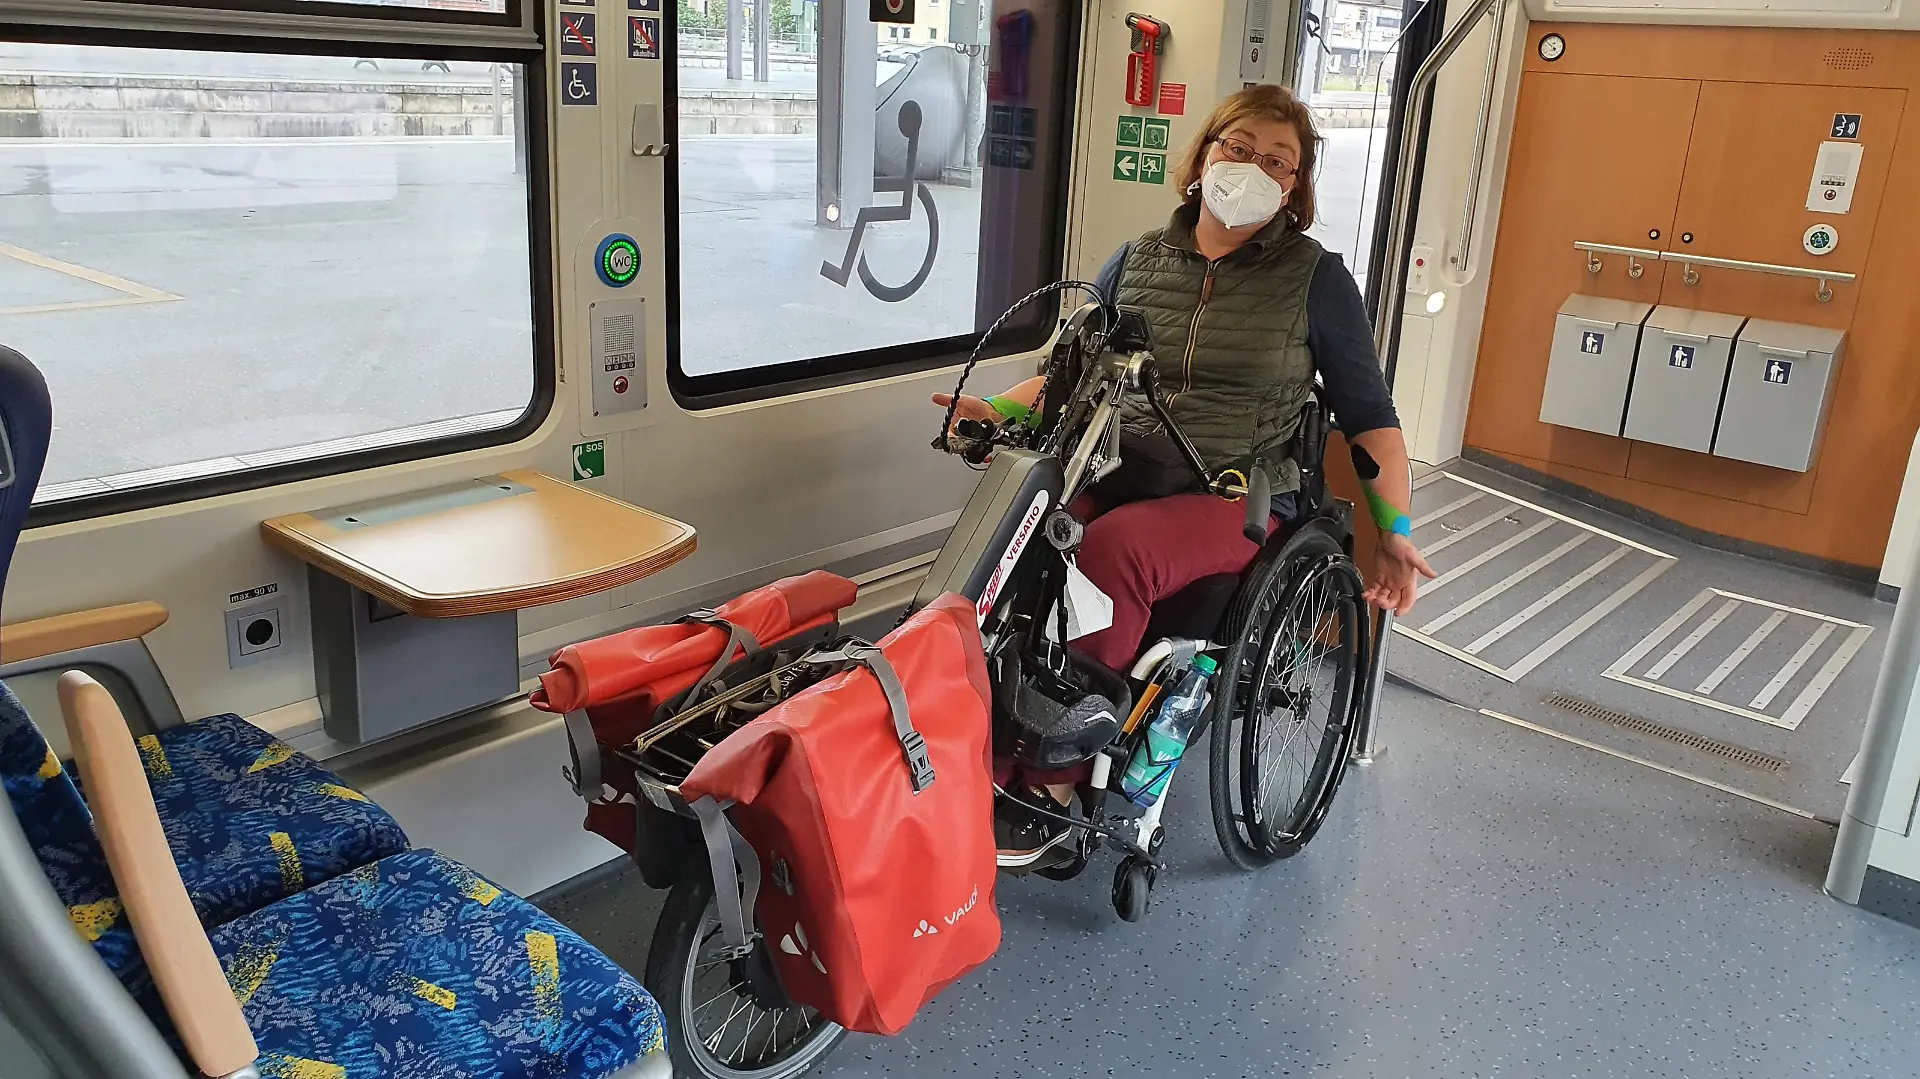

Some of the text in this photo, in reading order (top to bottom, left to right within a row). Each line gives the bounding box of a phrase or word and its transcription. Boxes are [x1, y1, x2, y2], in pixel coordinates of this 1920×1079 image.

[614, 256, 631, 268] WC
[586, 442, 603, 452] SOS
[1007, 505, 1040, 561] VERSATIO
[231, 584, 276, 603] max. 90 W
